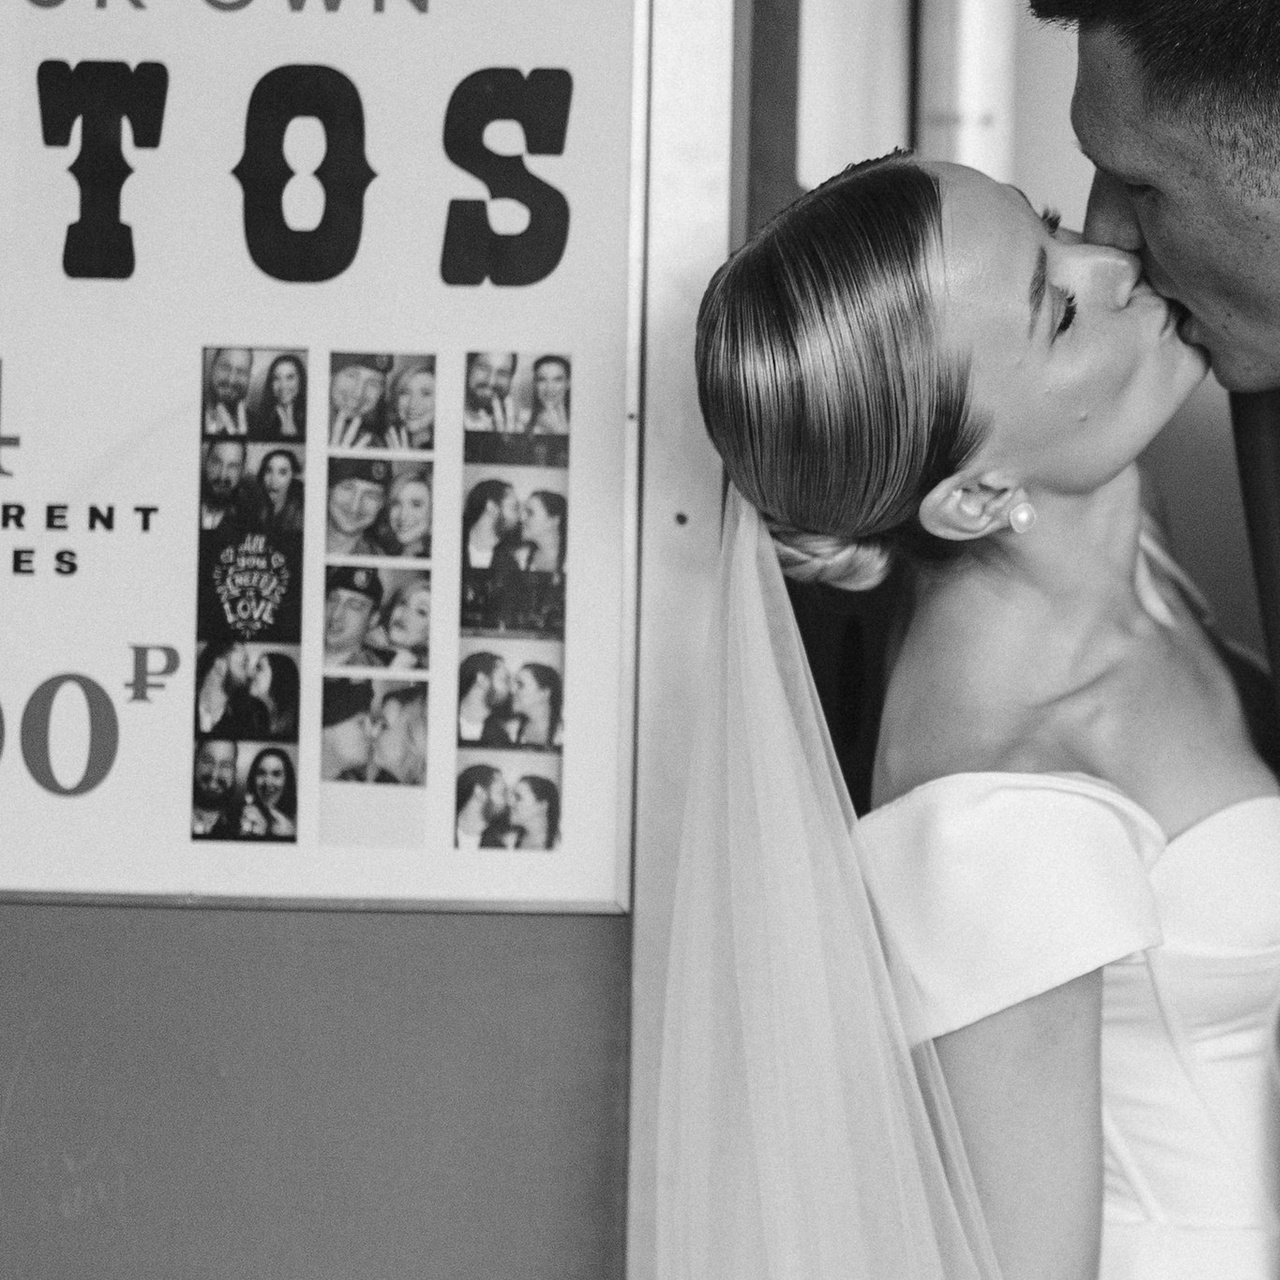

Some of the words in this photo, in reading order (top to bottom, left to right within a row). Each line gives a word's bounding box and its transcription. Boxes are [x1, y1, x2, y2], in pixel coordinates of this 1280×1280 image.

[36, 59, 574, 287] TOS
[1, 503, 159, 532] RENT
[12, 548, 78, 576] ES
[223, 599, 275, 625] LOVE
